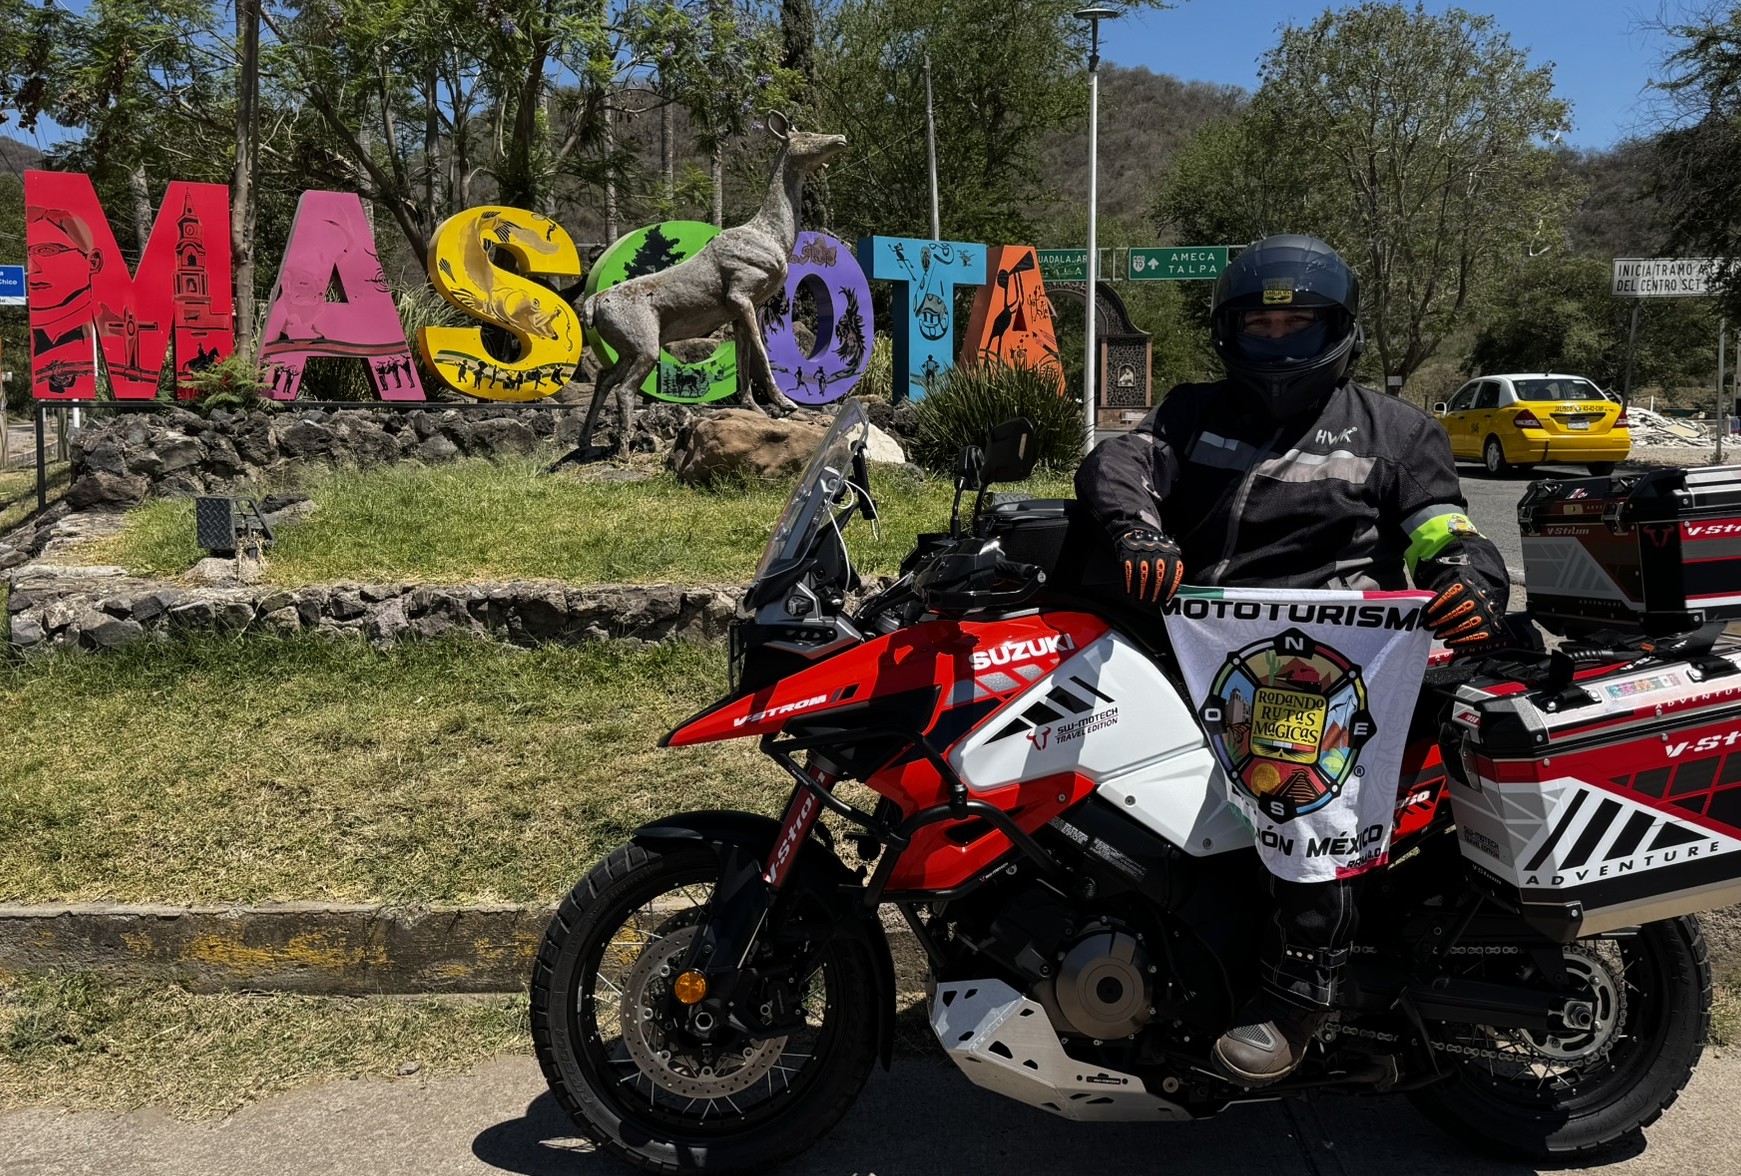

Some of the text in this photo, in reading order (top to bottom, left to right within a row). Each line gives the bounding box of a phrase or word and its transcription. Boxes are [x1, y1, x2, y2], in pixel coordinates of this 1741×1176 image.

[1171, 252, 1215, 261] AMECA
[1168, 265, 1217, 274] TALPA
[1618, 264, 1651, 277] INICIA
[1655, 264, 1693, 276] TRAMO
[24, 170, 1067, 403] MASCOTA
[1616, 280, 1637, 292] DEL
[1640, 279, 1677, 292] CENTRO
[1681, 278, 1701, 291] SCT
[1315, 428, 1353, 446] HWK
[1160, 597, 1425, 632] MOTOTURISM
[968, 633, 1075, 671] SUZUKI
[1285, 636, 1304, 651] N
[733, 694, 828, 728] V-STROM
[1057, 707, 1118, 735] SW-MOTECH
[1056, 717, 1118, 744] TRAVEL EDITION
[1354, 722, 1369, 736] E
[1270, 801, 1285, 817] S
[1305, 824, 1384, 858] MÉXICO
[1525, 841, 1720, 886] ADVENTURE
